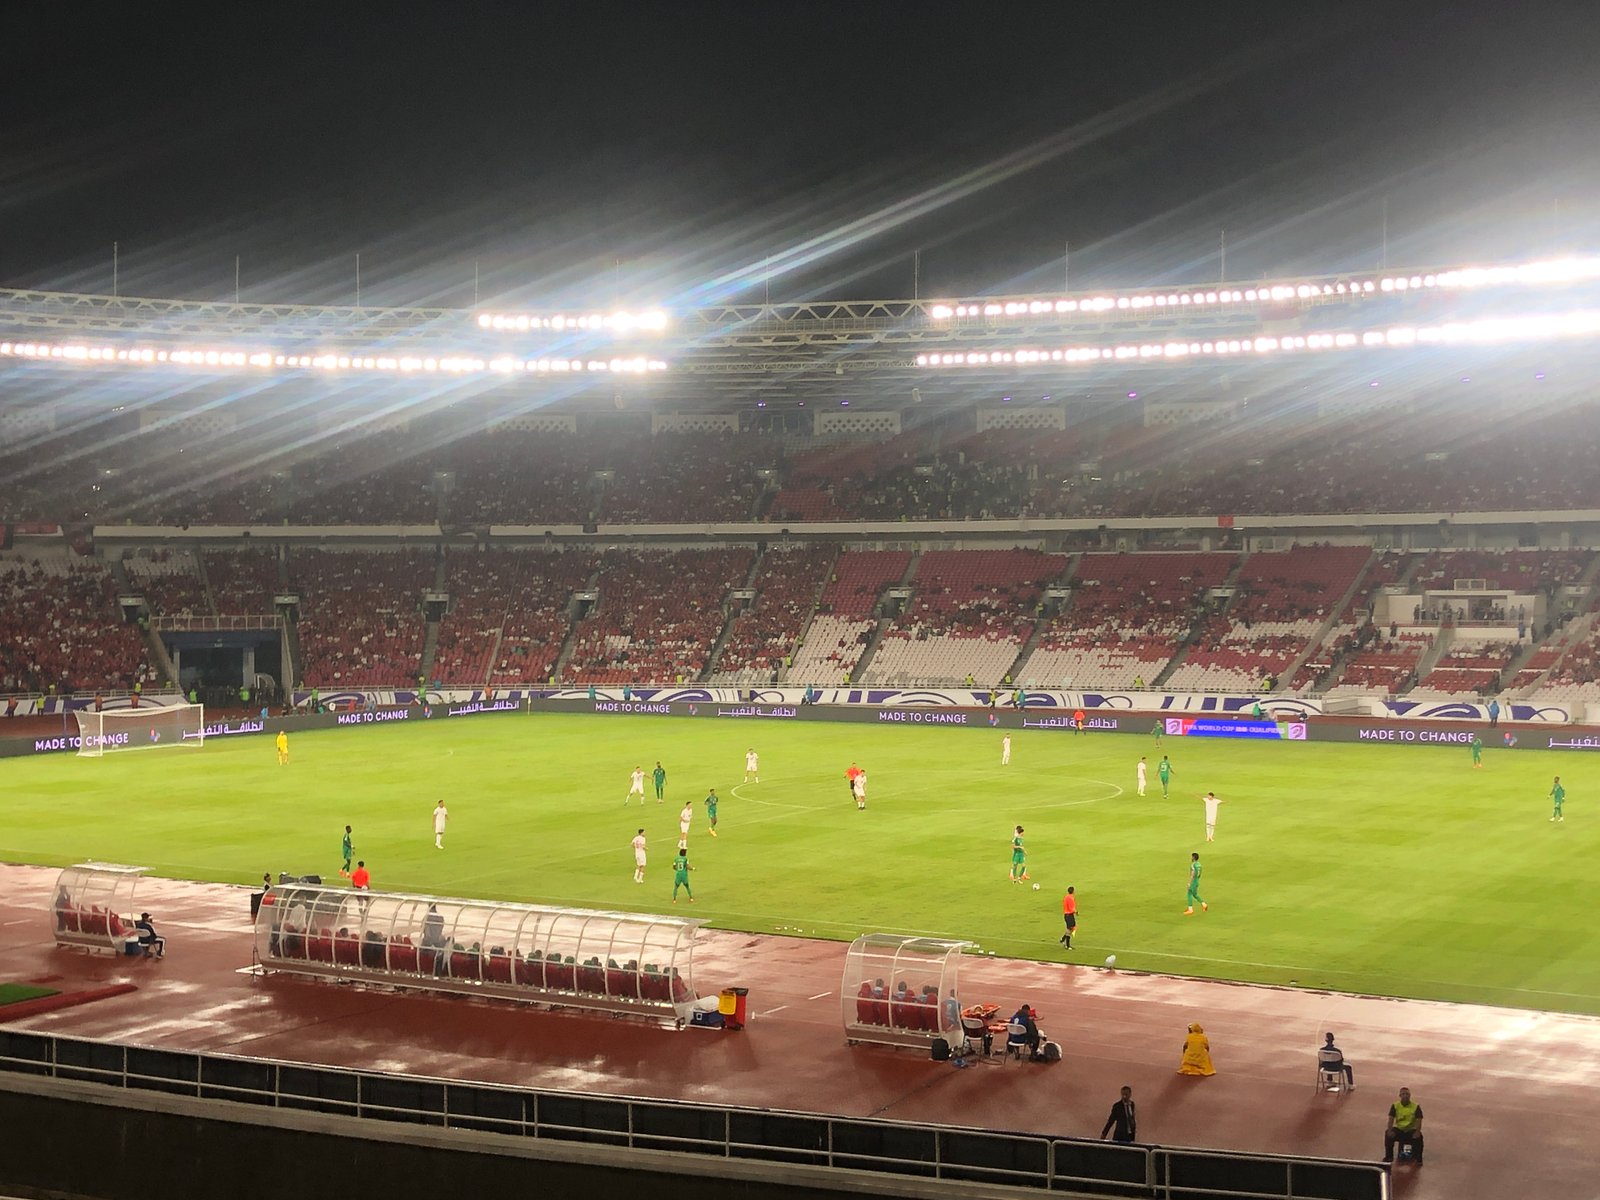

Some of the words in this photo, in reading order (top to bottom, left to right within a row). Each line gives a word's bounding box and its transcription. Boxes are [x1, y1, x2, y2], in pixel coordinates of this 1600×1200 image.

[595, 702, 619, 711] MADE
[621, 704, 631, 712] TO
[634, 704, 670, 713] CHANGE
[338, 713, 361, 724] MADE
[363, 712, 373, 722] TO
[376, 709, 409, 721] CHANGE
[879, 711, 906, 721] MADE
[908, 712, 922, 722] TO
[925, 713, 967, 724] CHANGE
[35, 738, 65, 751] MADE
[68, 736, 82, 748] TO
[85, 732, 129, 747] CHANGE
[1359, 729, 1395, 740] MADE
[1399, 730, 1415, 741] TO
[1419, 731, 1475, 743] CHANGE
